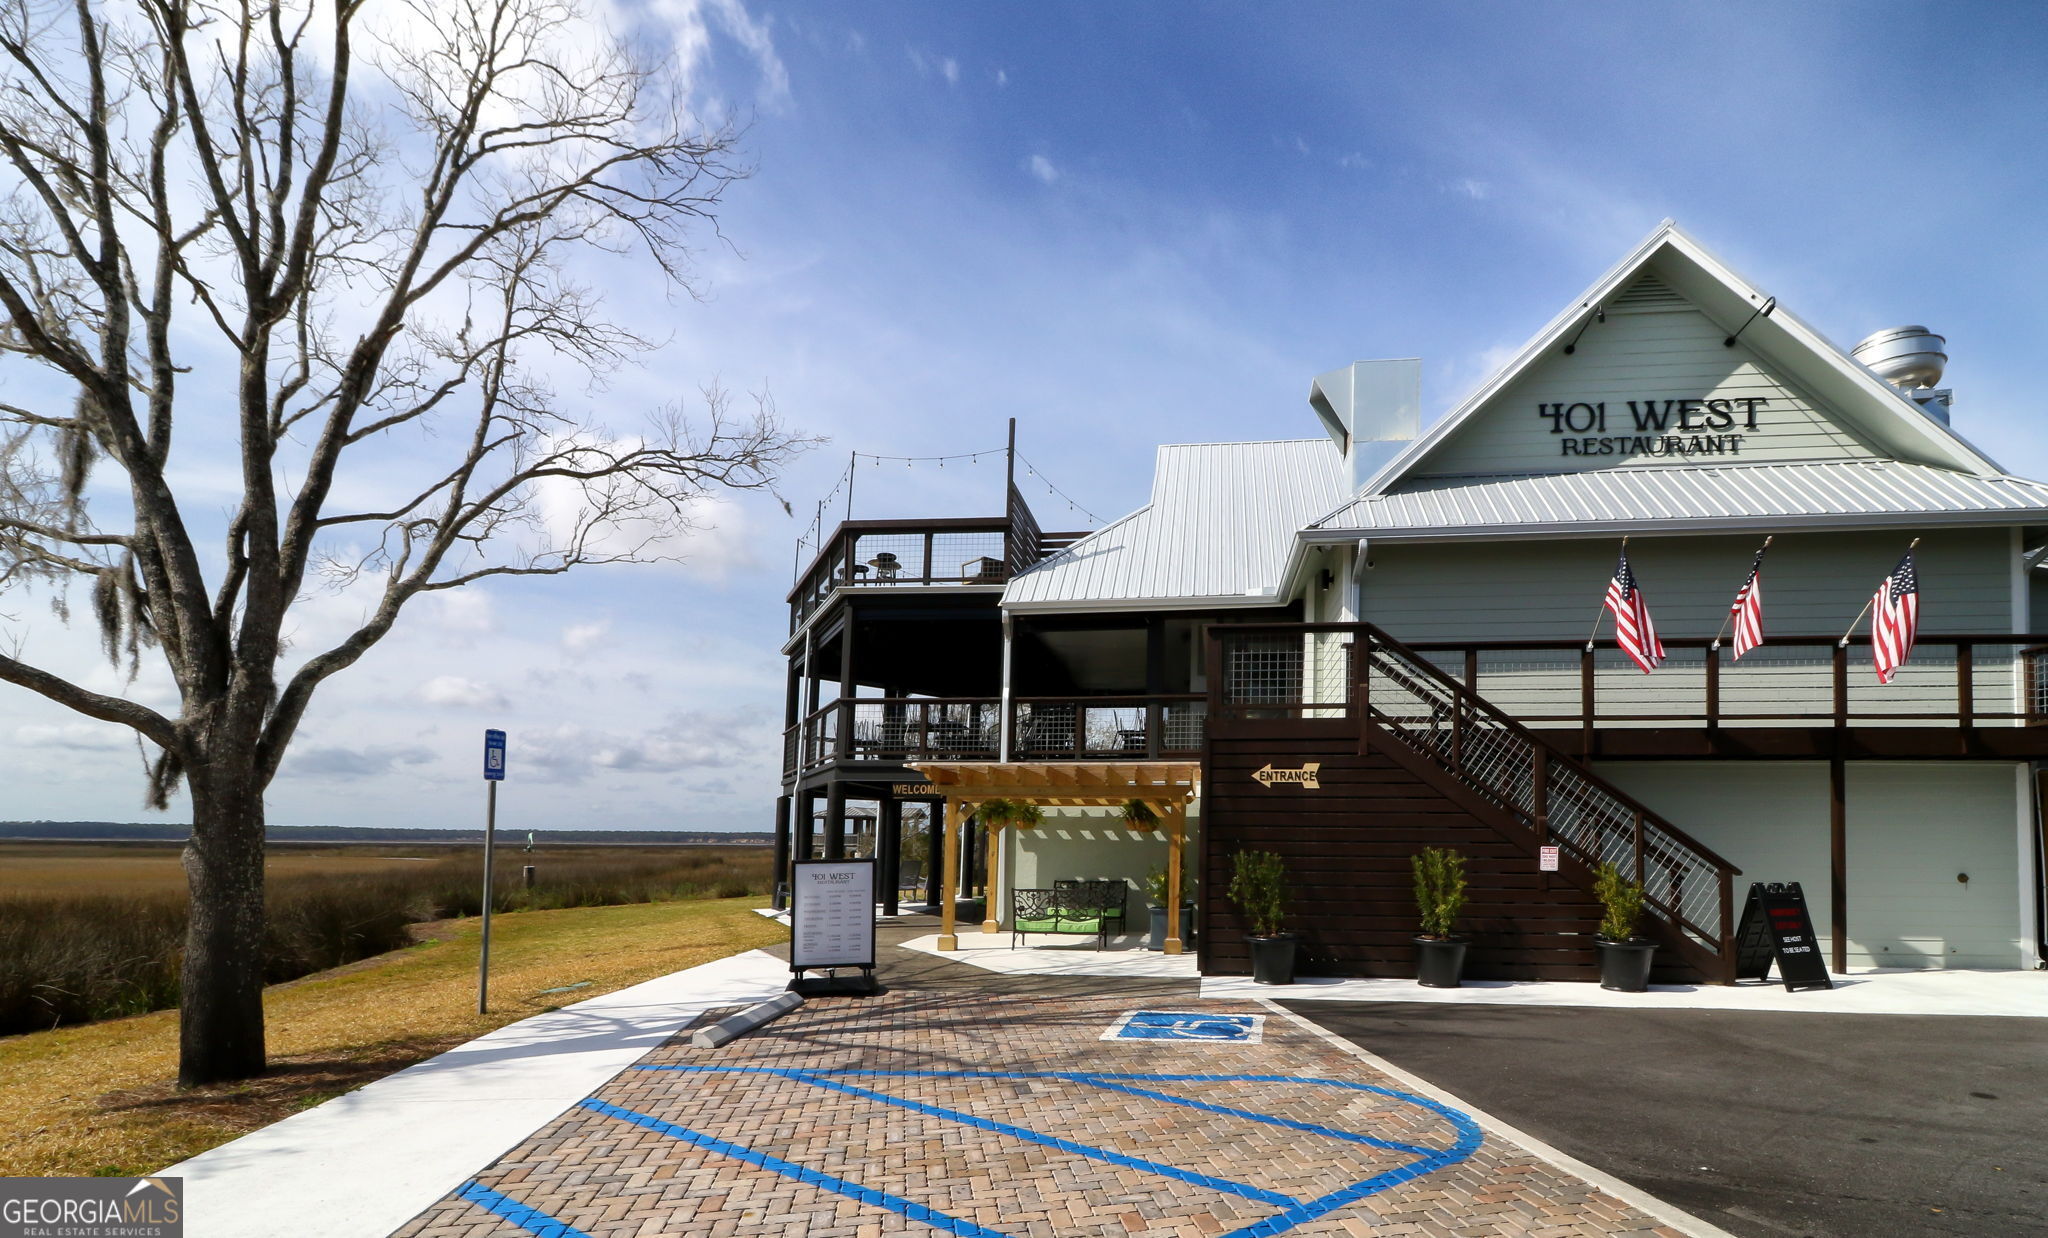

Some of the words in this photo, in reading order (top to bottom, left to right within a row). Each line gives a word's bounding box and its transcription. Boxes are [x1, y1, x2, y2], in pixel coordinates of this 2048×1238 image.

[1538, 401, 1606, 433] 401
[1627, 397, 1767, 432] WEST
[1561, 434, 1743, 456] RESTAURANT
[1259, 770, 1316, 781] ENTRANCE
[811, 872, 826, 881] 401
[829, 872, 856, 880] WEST
